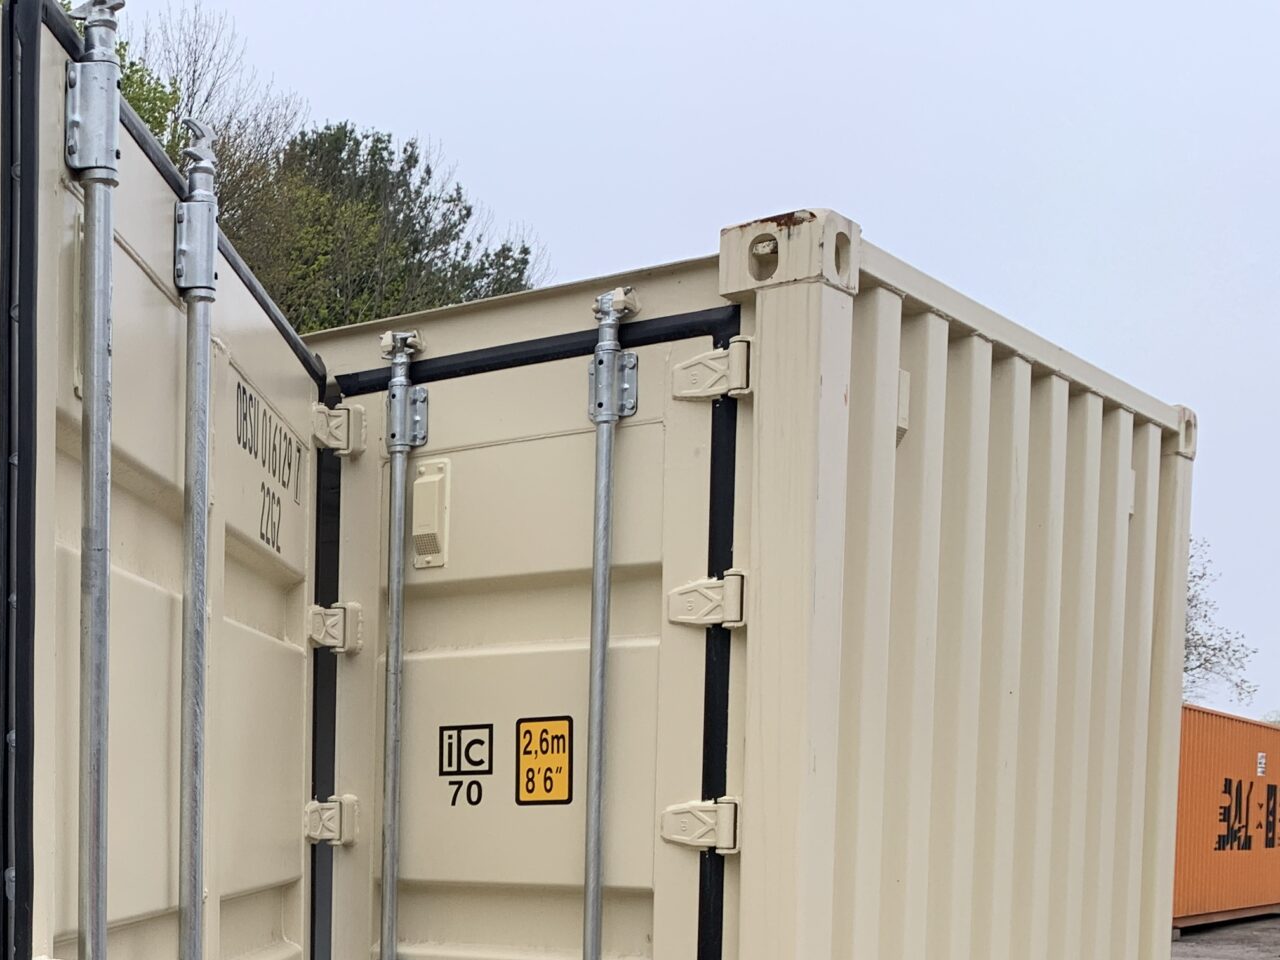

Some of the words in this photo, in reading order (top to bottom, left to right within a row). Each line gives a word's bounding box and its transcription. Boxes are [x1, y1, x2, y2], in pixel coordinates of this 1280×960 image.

[236, 381, 260, 460] OBSU
[262, 408, 292, 490] 016129
[260, 481, 281, 554] 22G2
[522, 728, 567, 760] 2,6m
[448, 780, 483, 807] 70
